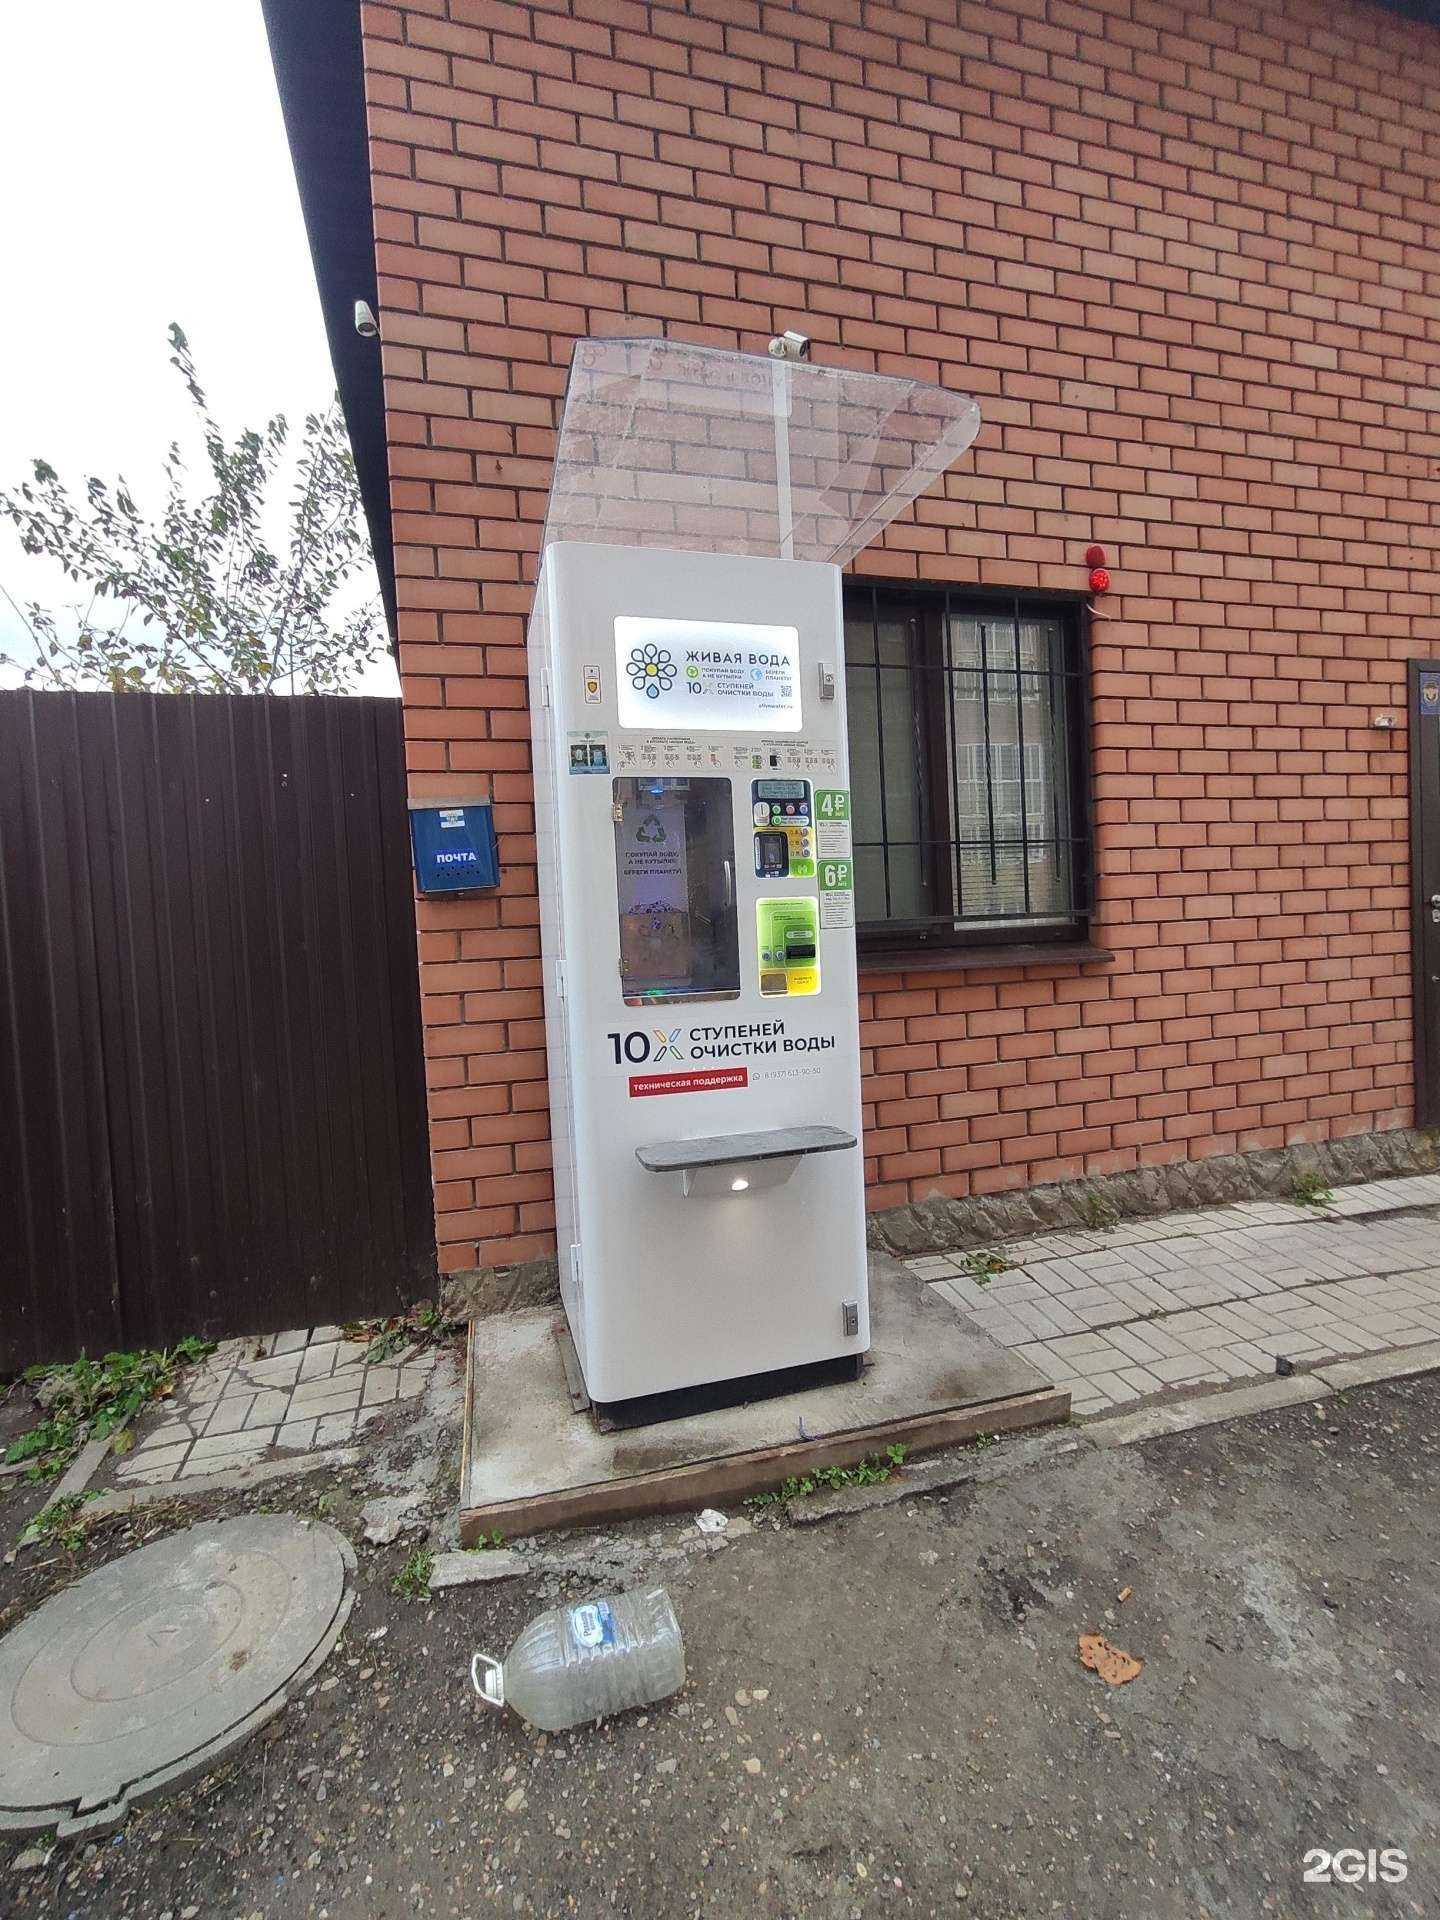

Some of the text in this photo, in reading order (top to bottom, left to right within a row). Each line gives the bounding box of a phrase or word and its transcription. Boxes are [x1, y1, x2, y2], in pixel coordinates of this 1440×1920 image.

[686, 650, 790, 667] ЖИВАЯ ВОДА
[717, 682, 754, 690] СТУПЕНЕЙ
[436, 852, 477, 863] ПОЧТА
[689, 1019, 785, 1042] СТУПЕНЕЙ
[690, 1035, 835, 1060] ОЧИСТКИ ВОДЫ
[633, 1073, 743, 1092] техническая поддержка
